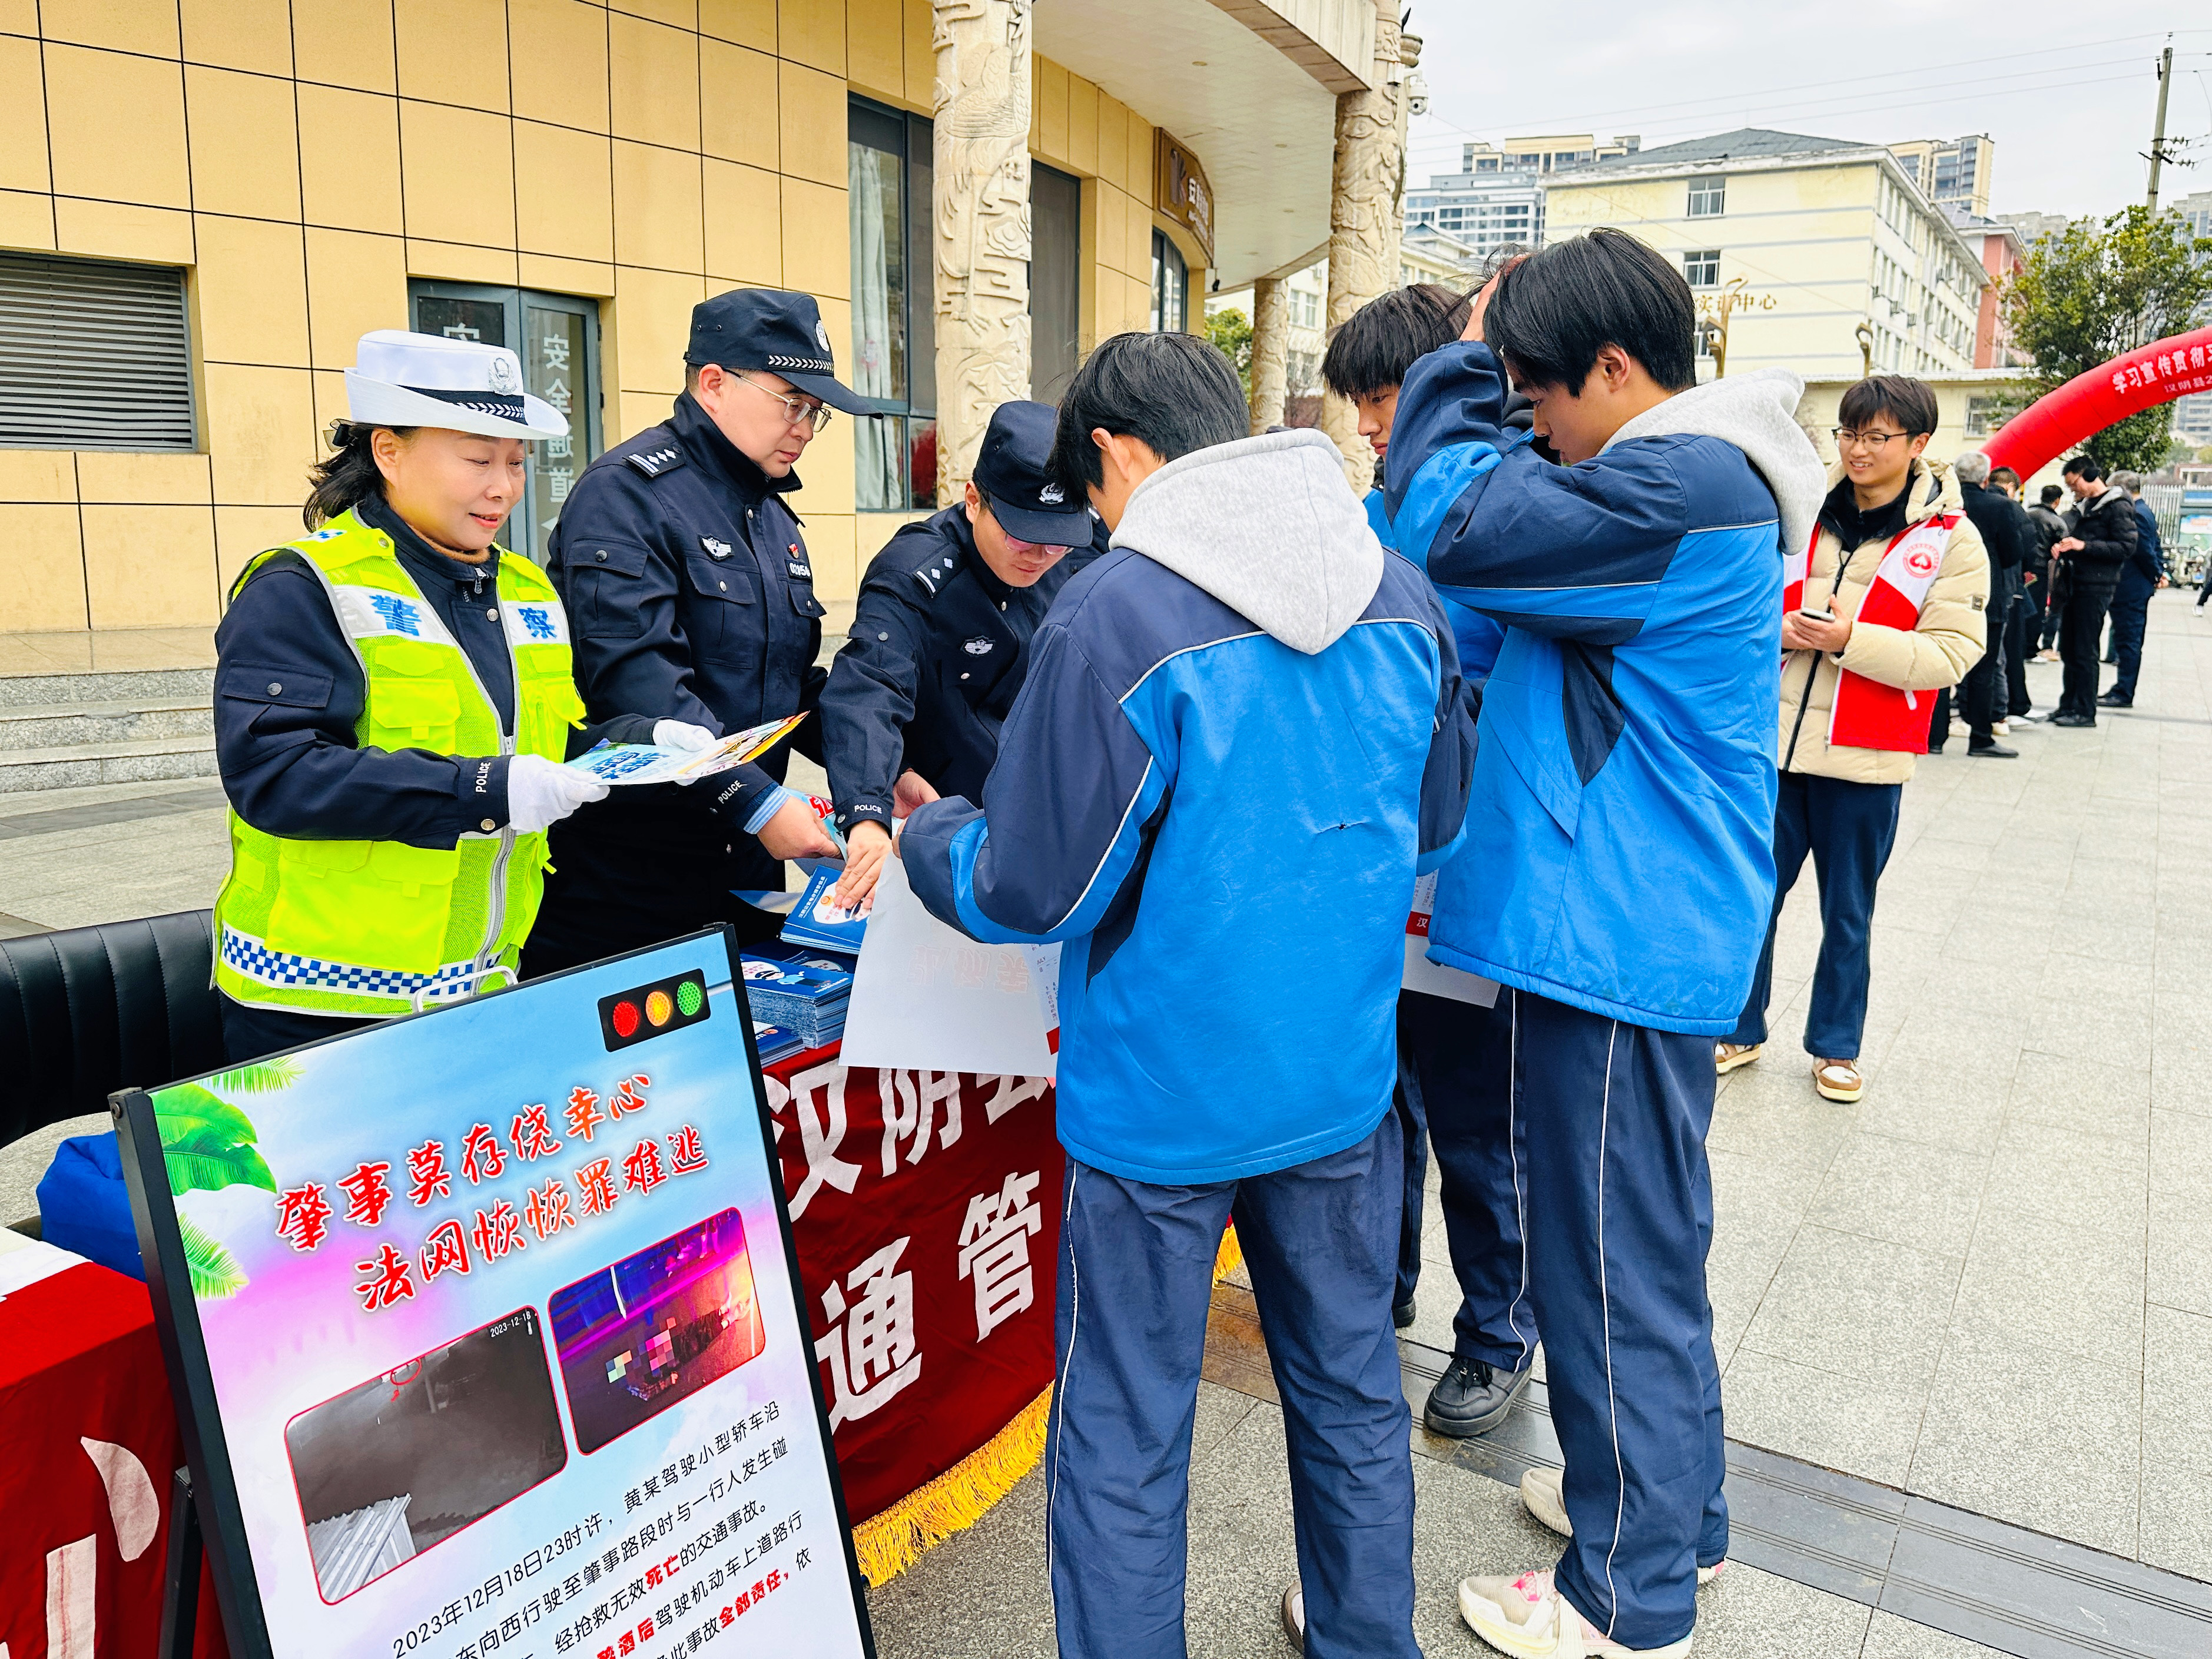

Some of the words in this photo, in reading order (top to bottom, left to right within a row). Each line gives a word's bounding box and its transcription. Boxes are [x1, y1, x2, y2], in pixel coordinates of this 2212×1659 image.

[369, 594, 420, 636] 警
[518, 607, 557, 639] 察
[475, 761, 491, 793] POLICE
[718, 779, 742, 805] POLICE
[854, 804, 883, 814] POLICE
[275, 1074, 651, 1252] 肇事莫存侥幸心
[354, 1124, 709, 1312] 法网恢恢罪难逃
[490, 1310, 531, 1338] 2023-12-18
